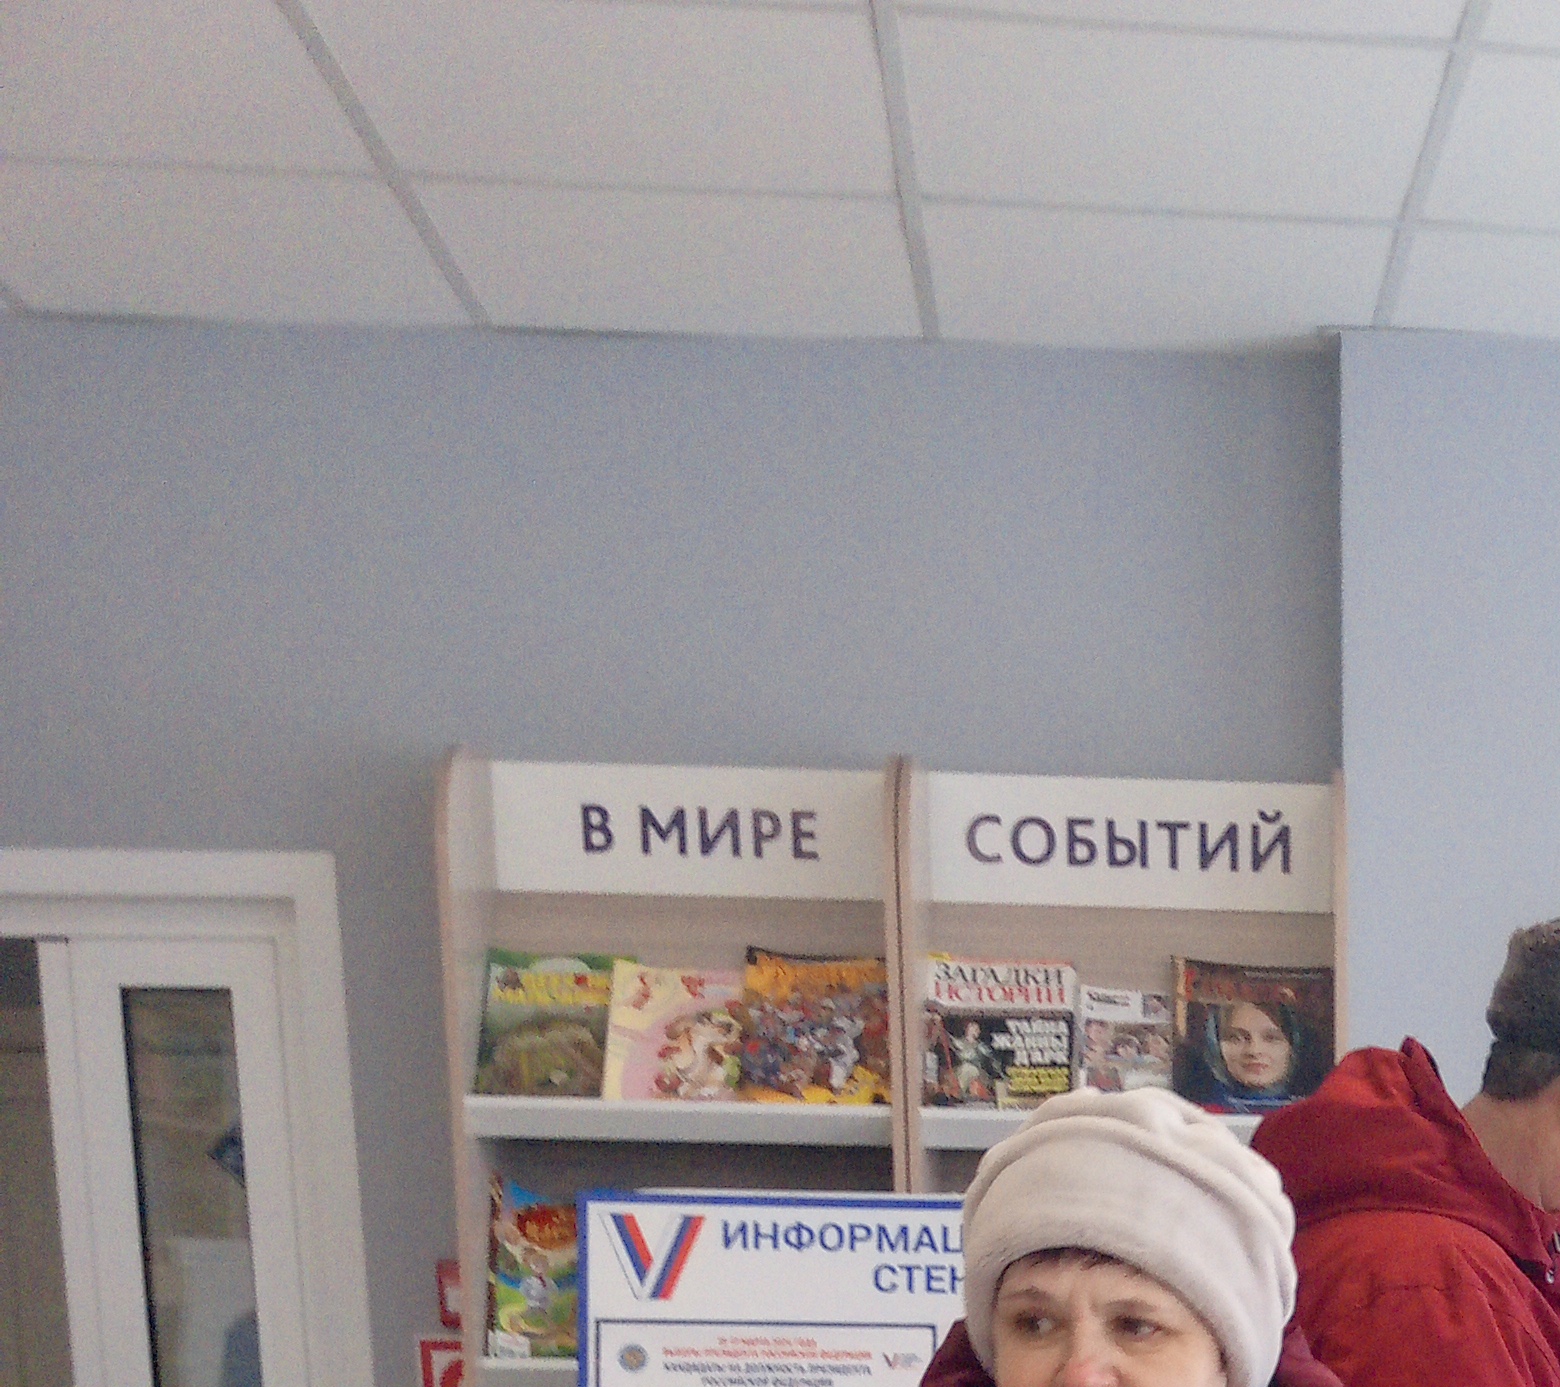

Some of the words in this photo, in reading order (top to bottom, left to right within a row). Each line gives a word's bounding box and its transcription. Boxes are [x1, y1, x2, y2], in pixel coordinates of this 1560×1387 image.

[581, 803, 613, 854] В
[638, 804, 820, 861] МИРЕ
[965, 808, 1292, 874] СОБЫТИЙ
